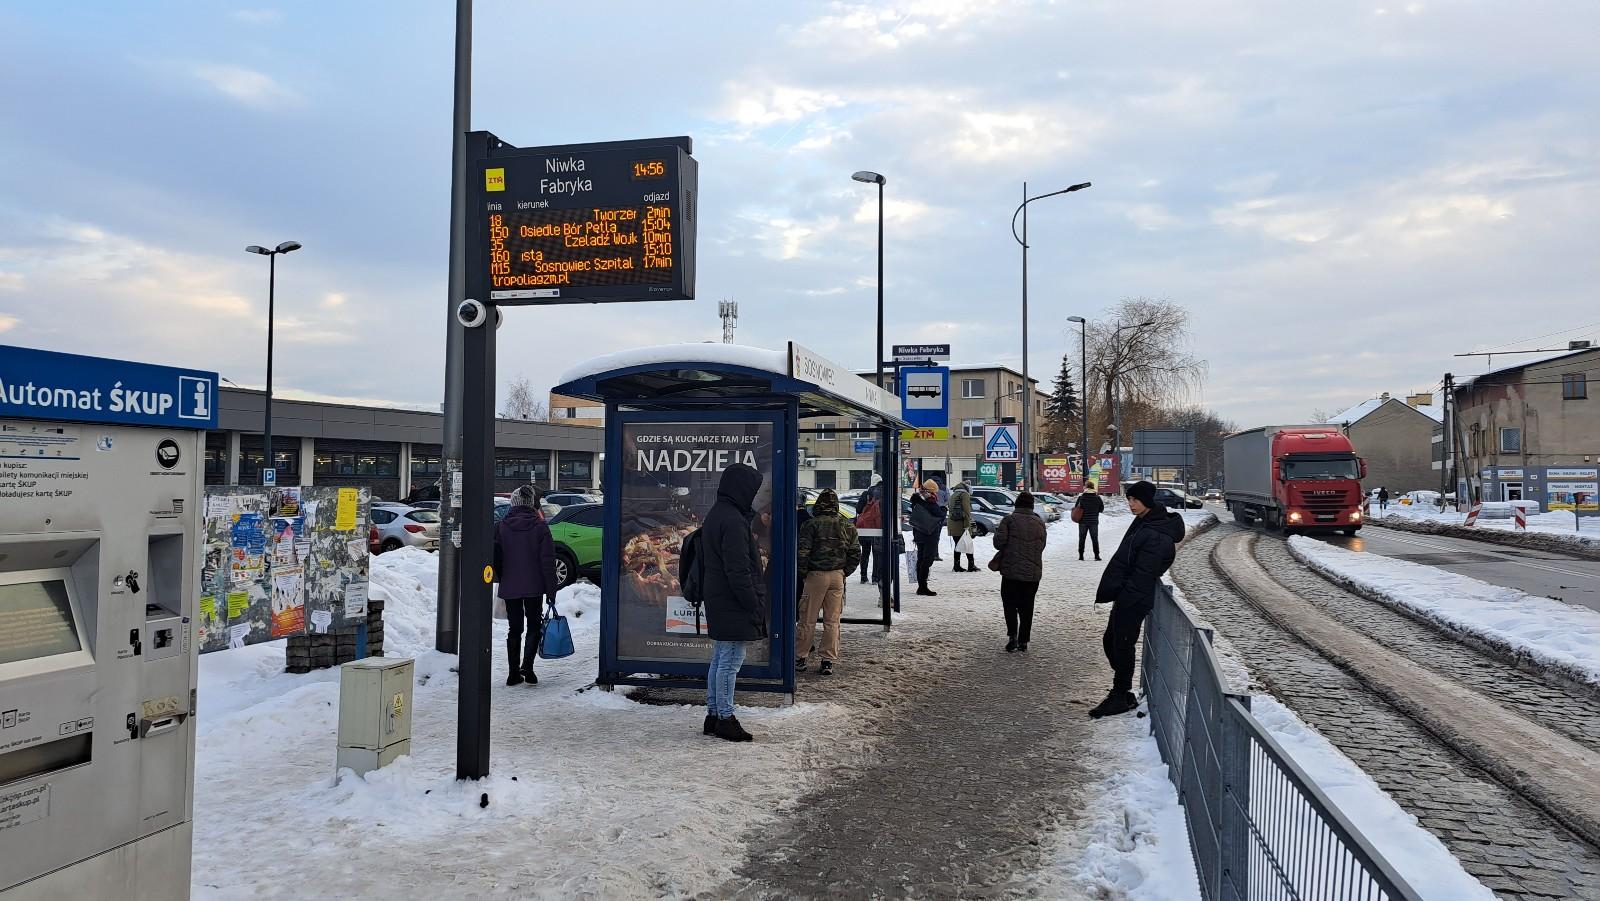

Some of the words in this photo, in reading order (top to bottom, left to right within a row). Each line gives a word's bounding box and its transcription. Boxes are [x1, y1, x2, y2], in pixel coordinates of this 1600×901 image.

[546, 157, 585, 173] Niwka
[634, 162, 664, 177] 14:56
[540, 177, 592, 196] Fabryka
[487, 201, 502, 211] linia
[517, 199, 550, 209] kierunek
[643, 191, 670, 203] odjazd
[489, 214, 502, 227] 18
[646, 206, 671, 219] 2min
[490, 226, 509, 239] 150
[520, 224, 560, 238] Osiedle
[563, 222, 582, 236] Bór
[642, 218, 671, 231] 15:04
[490, 238, 504, 251] 35
[613, 232, 638, 245] Wojk
[642, 231, 672, 244] 10min
[490, 250, 510, 263] 160
[643, 242, 672, 256] 15:10
[491, 262, 510, 275] M15
[535, 259, 591, 273] Sosnowiec
[593, 257, 634, 271] Szpital
[643, 255, 672, 268] 17min
[109, 380, 173, 415] ŚKUP
[636, 435, 661, 443] GDZIE
[662, 435, 674, 445] SĄ
[675, 435, 719, 443] KUCHARZE
[721, 435, 739, 444] TAM
[740, 435, 760, 444] JEST
[914, 429, 935, 438] ZTM
[19, 472, 60, 480] komunikacji
[60, 472, 89, 480] miejskiej
[1043, 466, 1067, 478] COŚ
[0, 481, 17, 489] artę
